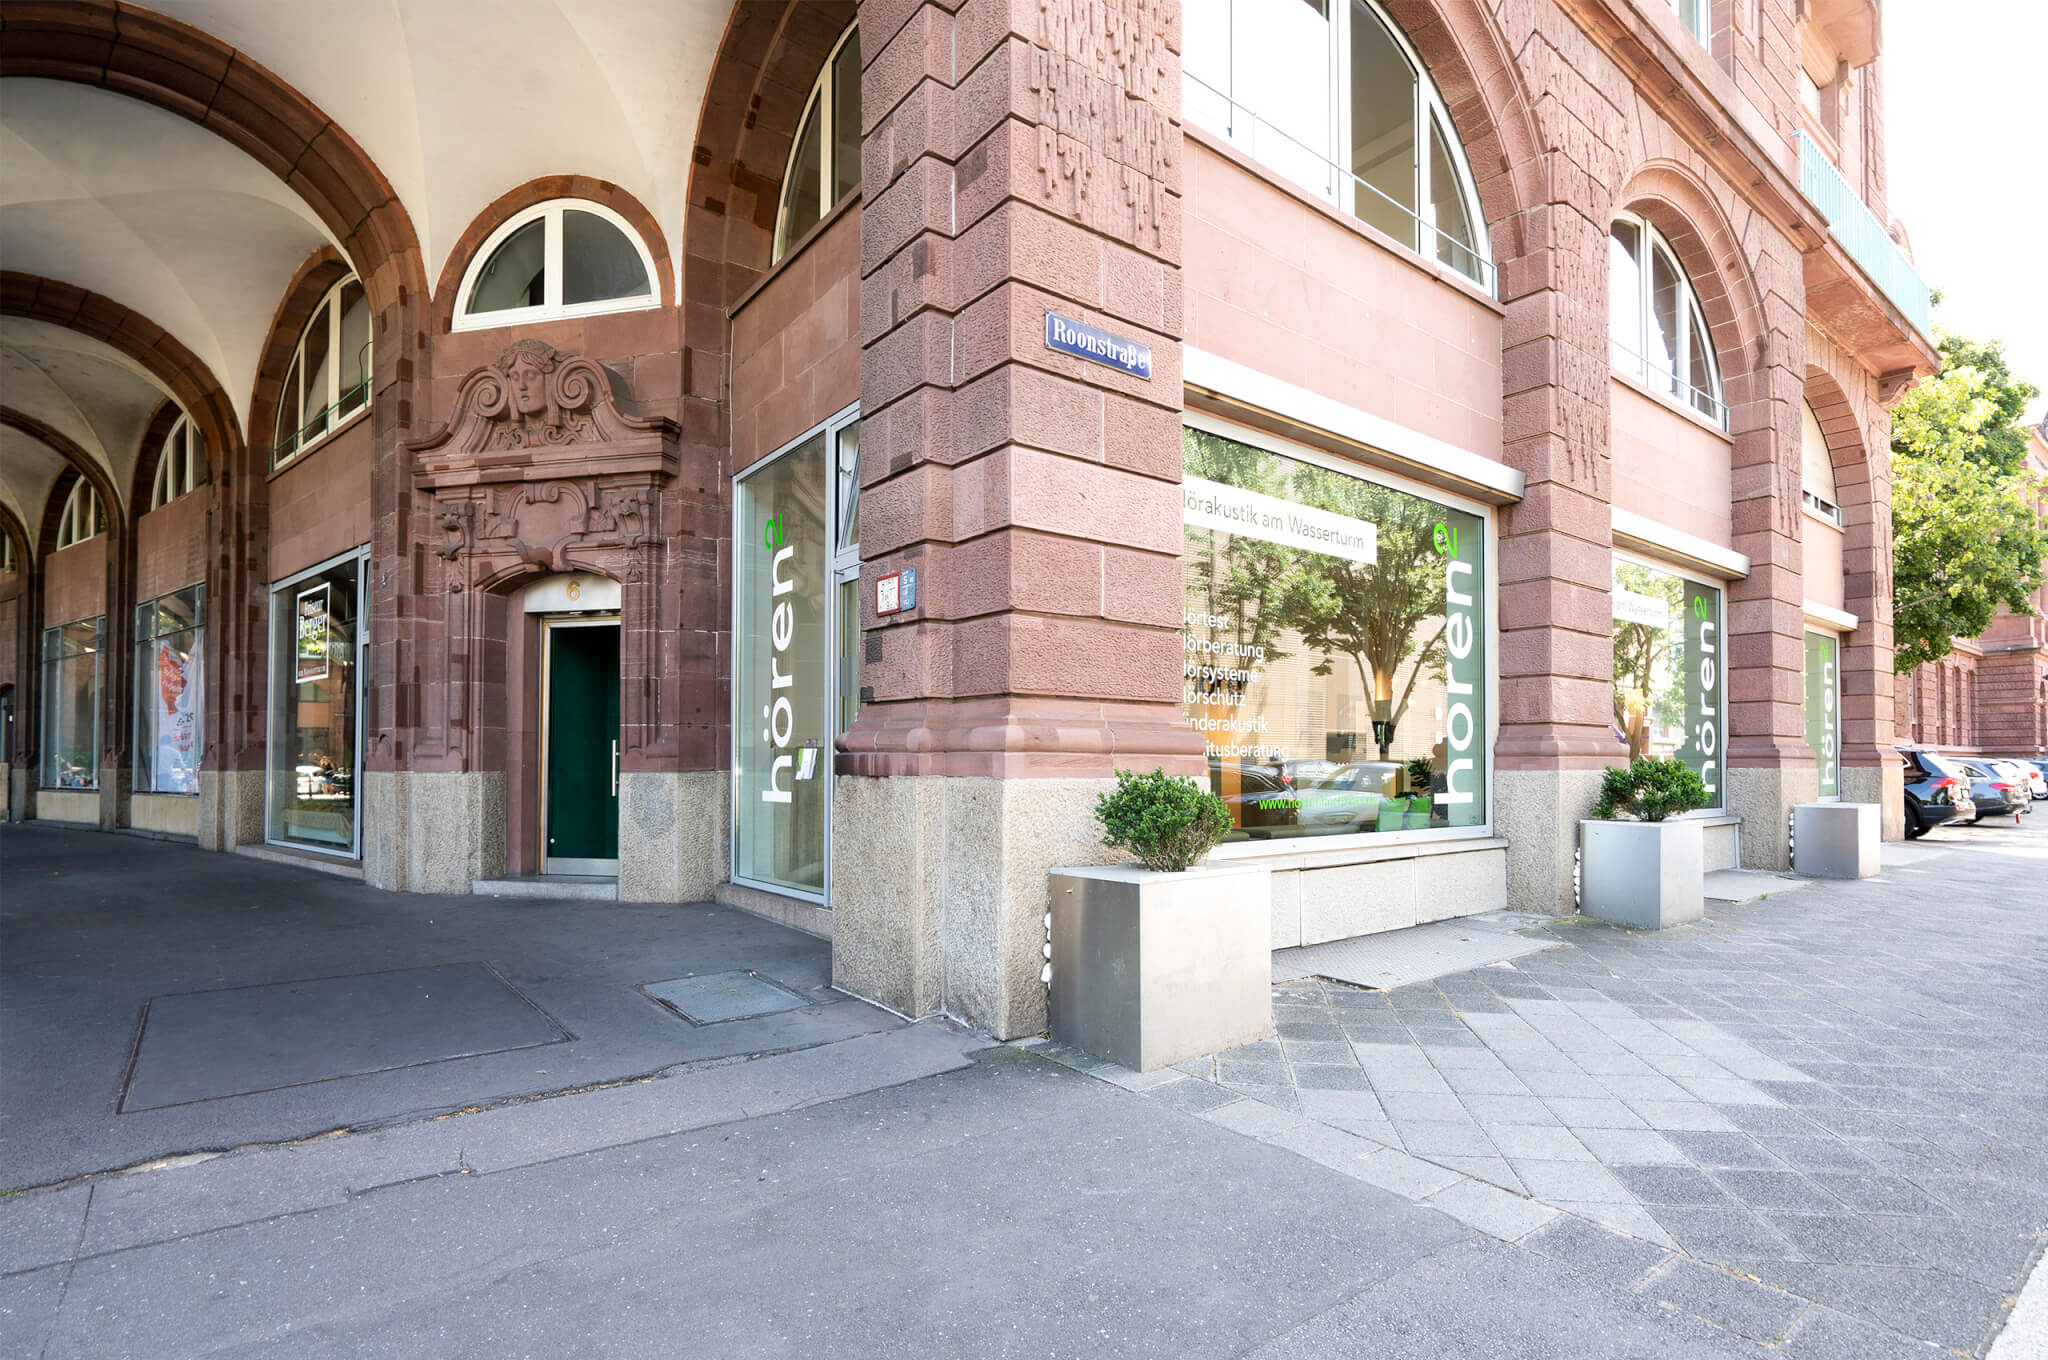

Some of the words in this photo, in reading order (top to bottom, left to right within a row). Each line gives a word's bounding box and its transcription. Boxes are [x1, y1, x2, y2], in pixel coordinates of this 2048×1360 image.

[1053, 317, 1146, 370] Roonstraße
[1262, 512, 1284, 531] am
[1288, 514, 1365, 550] Wasserturm
[567, 580, 580, 601] 6
[1184, 711, 1269, 733] inderakustik
[1203, 738, 1289, 763] itusberatung
